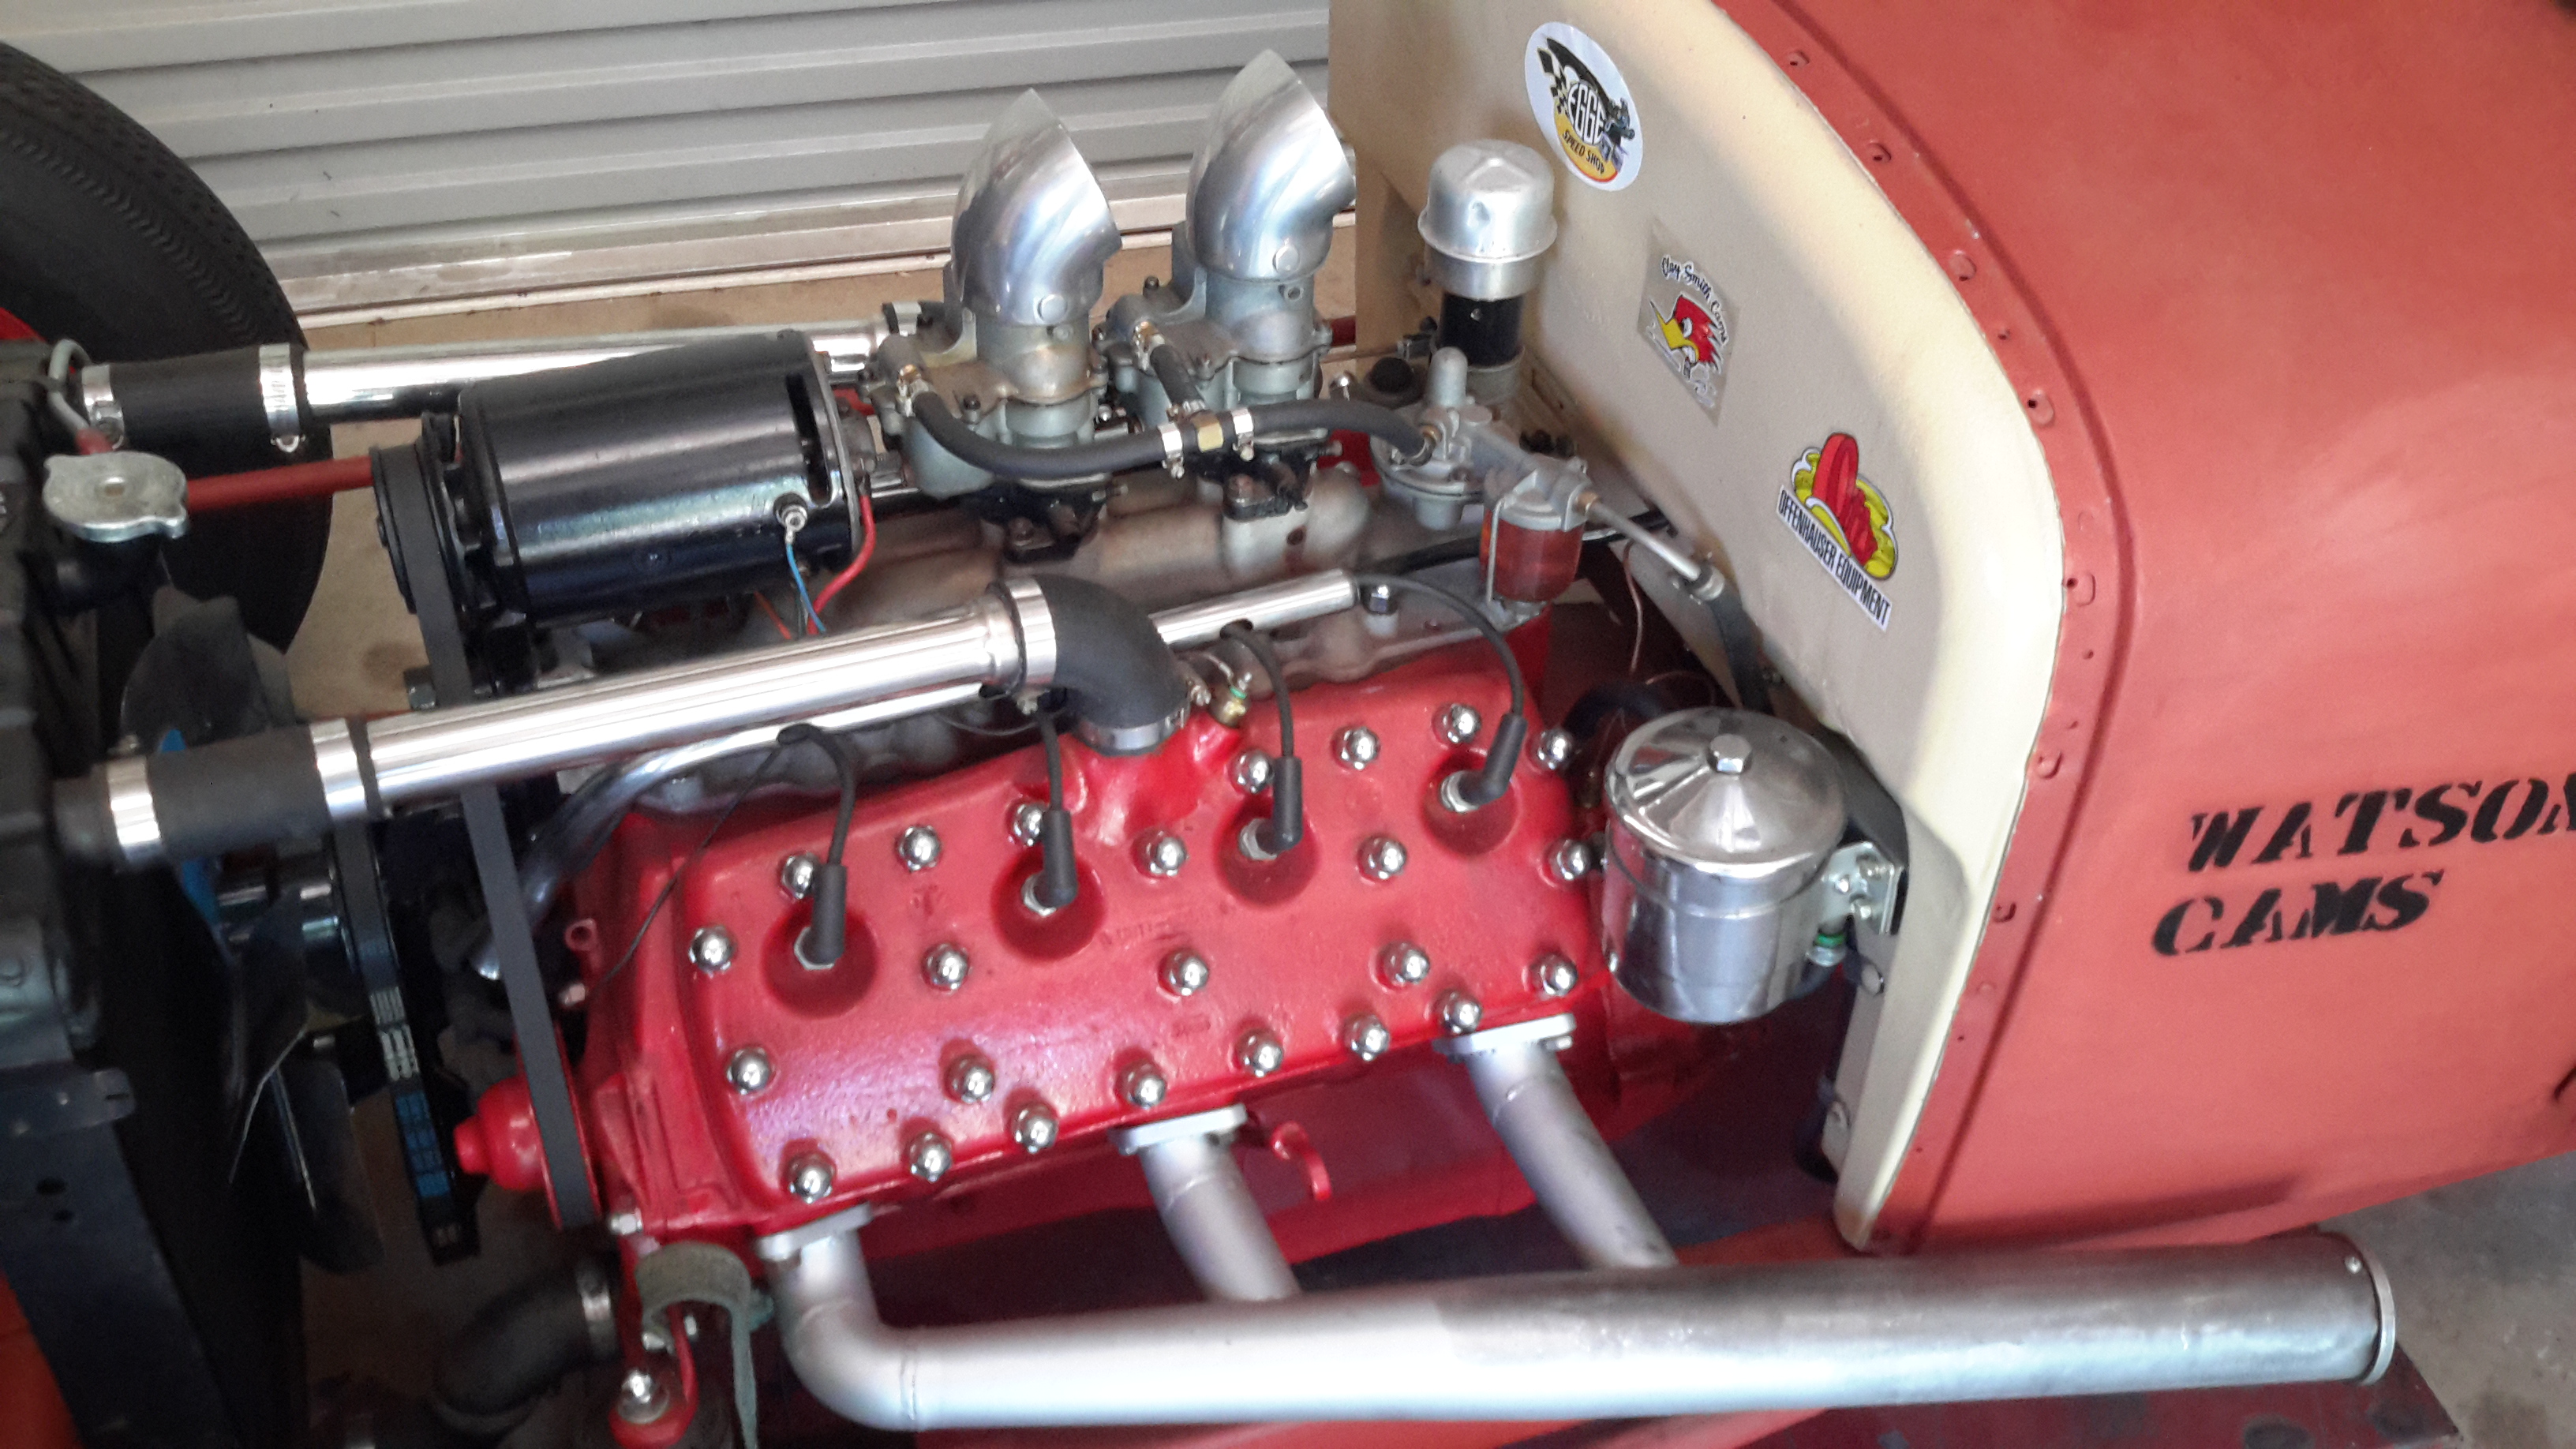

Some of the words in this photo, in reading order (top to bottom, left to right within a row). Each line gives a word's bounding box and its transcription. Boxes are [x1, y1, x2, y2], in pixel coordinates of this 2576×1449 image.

[1562, 129, 1586, 158] SPEED
[1586, 151, 1605, 174] SHOP
[1661, 256, 1681, 280] Clay
[1684, 264, 1712, 300] Smith
[1777, 489, 1837, 571] OFFENHAUSER
[1836, 553, 1891, 627] EQUIPMENT
[2151, 869, 2444, 956] CAMS
